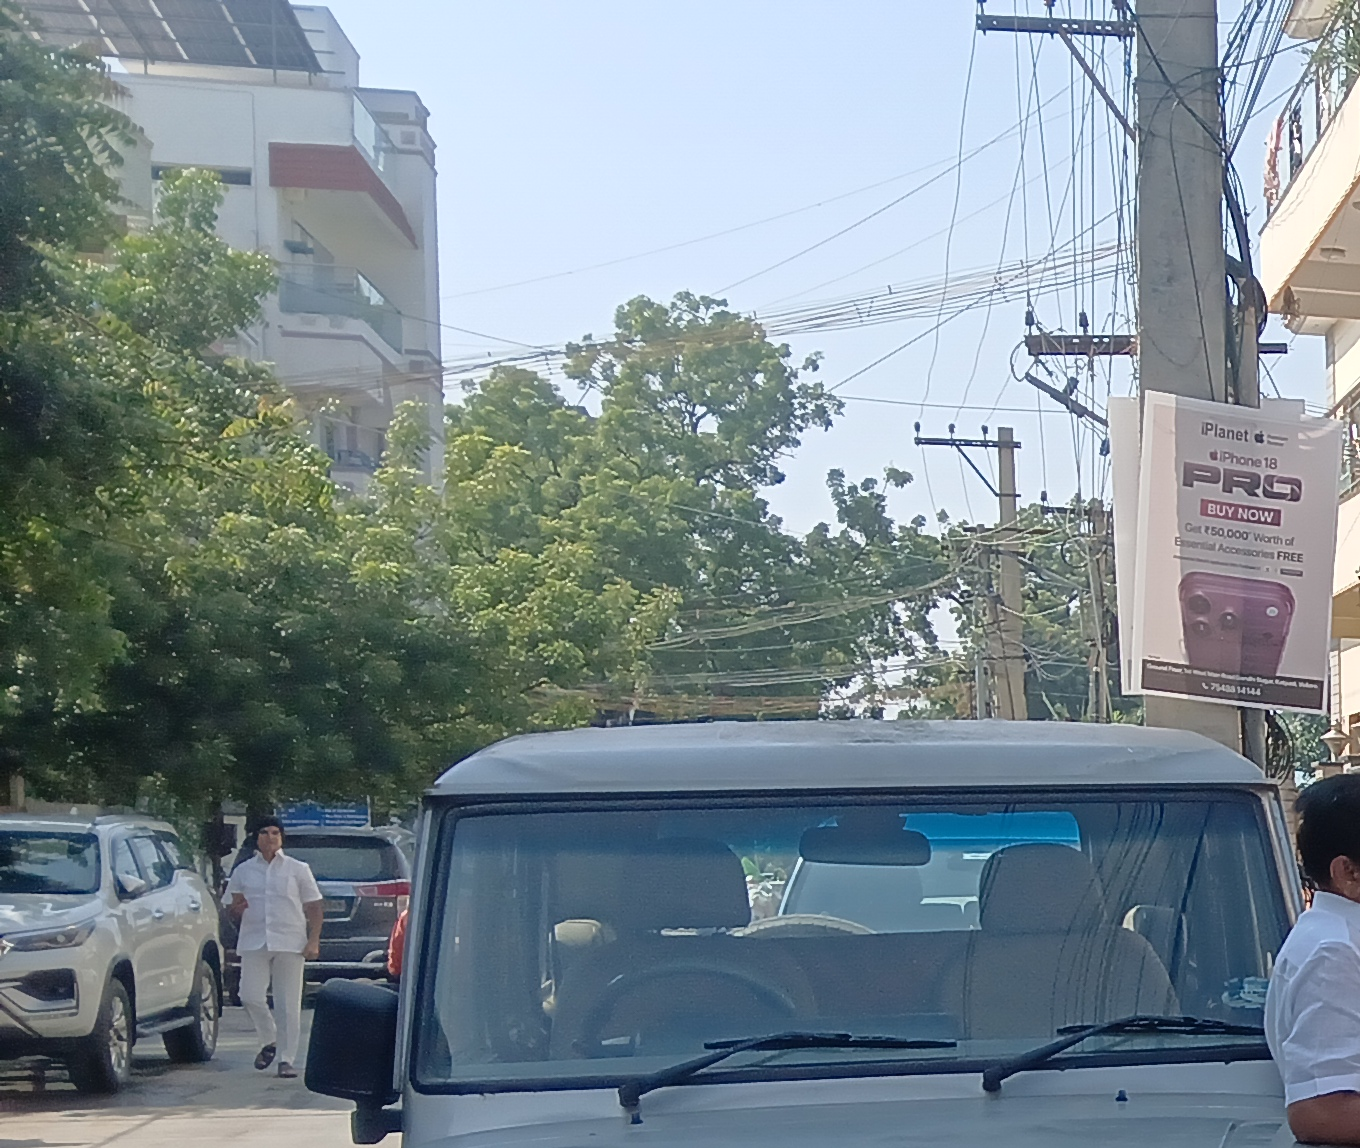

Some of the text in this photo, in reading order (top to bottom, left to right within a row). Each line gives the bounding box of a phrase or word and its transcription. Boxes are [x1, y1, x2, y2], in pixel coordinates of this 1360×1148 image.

[1201, 421, 1248, 442] iPlanet
[1219, 450, 1278, 469] iPhone 18
[1182, 461, 1302, 502] PRO
[1207, 503, 1274, 523] BUY NOW
[1253, 533, 1283, 545] Worth
[1276, 550, 1304, 563] FREE
